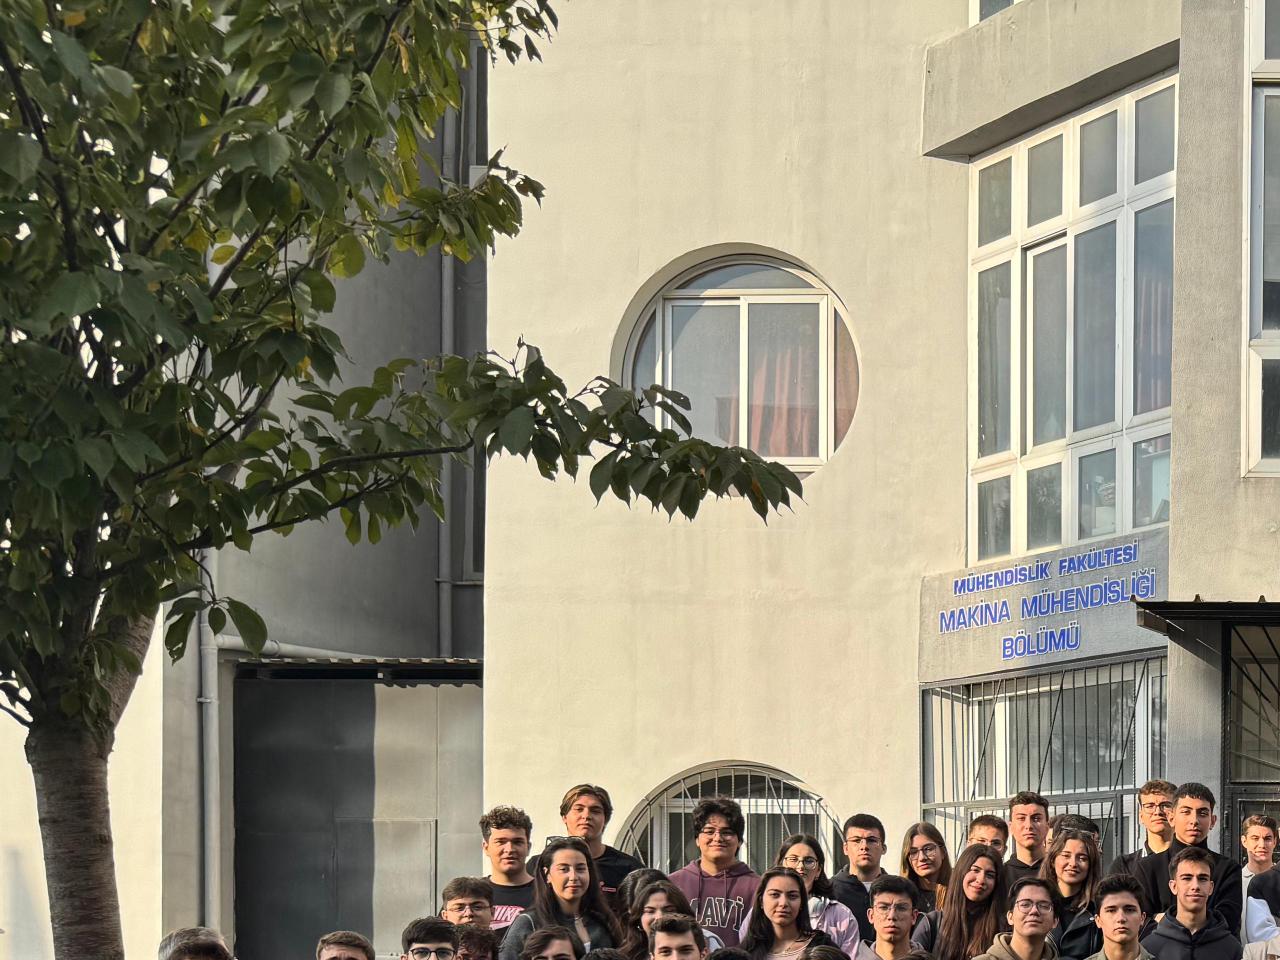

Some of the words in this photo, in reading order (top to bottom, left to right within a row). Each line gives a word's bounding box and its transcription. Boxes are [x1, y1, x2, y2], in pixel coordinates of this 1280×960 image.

[953, 559, 1052, 596] MÜHENDİSLİK
[1058, 539, 1140, 577] FAKÜLTESİ
[939, 599, 1011, 634] MAKİNA
[1020, 567, 1157, 620] MÜHENDİSLİĞİ
[1001, 620, 1081, 660] BÖLÜMÜ
